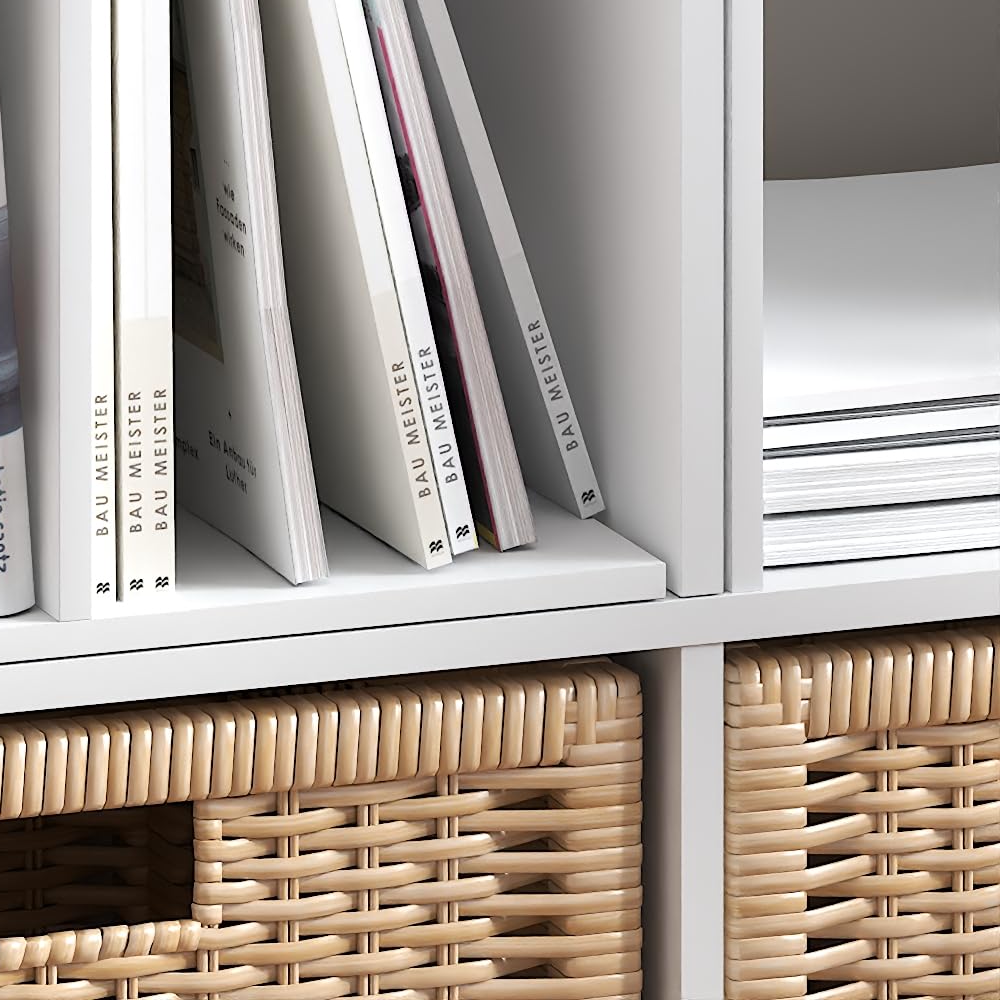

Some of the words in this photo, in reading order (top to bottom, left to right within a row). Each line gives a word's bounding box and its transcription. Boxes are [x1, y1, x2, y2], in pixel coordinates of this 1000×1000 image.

[418, 346, 448, 431] MEISTER
[528, 319, 564, 402] MEISTER
[153, 388, 168, 476] MEISTER
[391, 360, 421, 446] MEISTER
[556, 411, 579, 452] BAU
[94, 394, 108, 482] MEISTER
[128, 391, 142, 479] MEISTER
[438, 442, 459, 484] BAU
[412, 457, 432, 499] BAU
[95, 494, 109, 536] BAU
[129, 491, 142, 533] BAU
[155, 489, 168, 531] BAU
